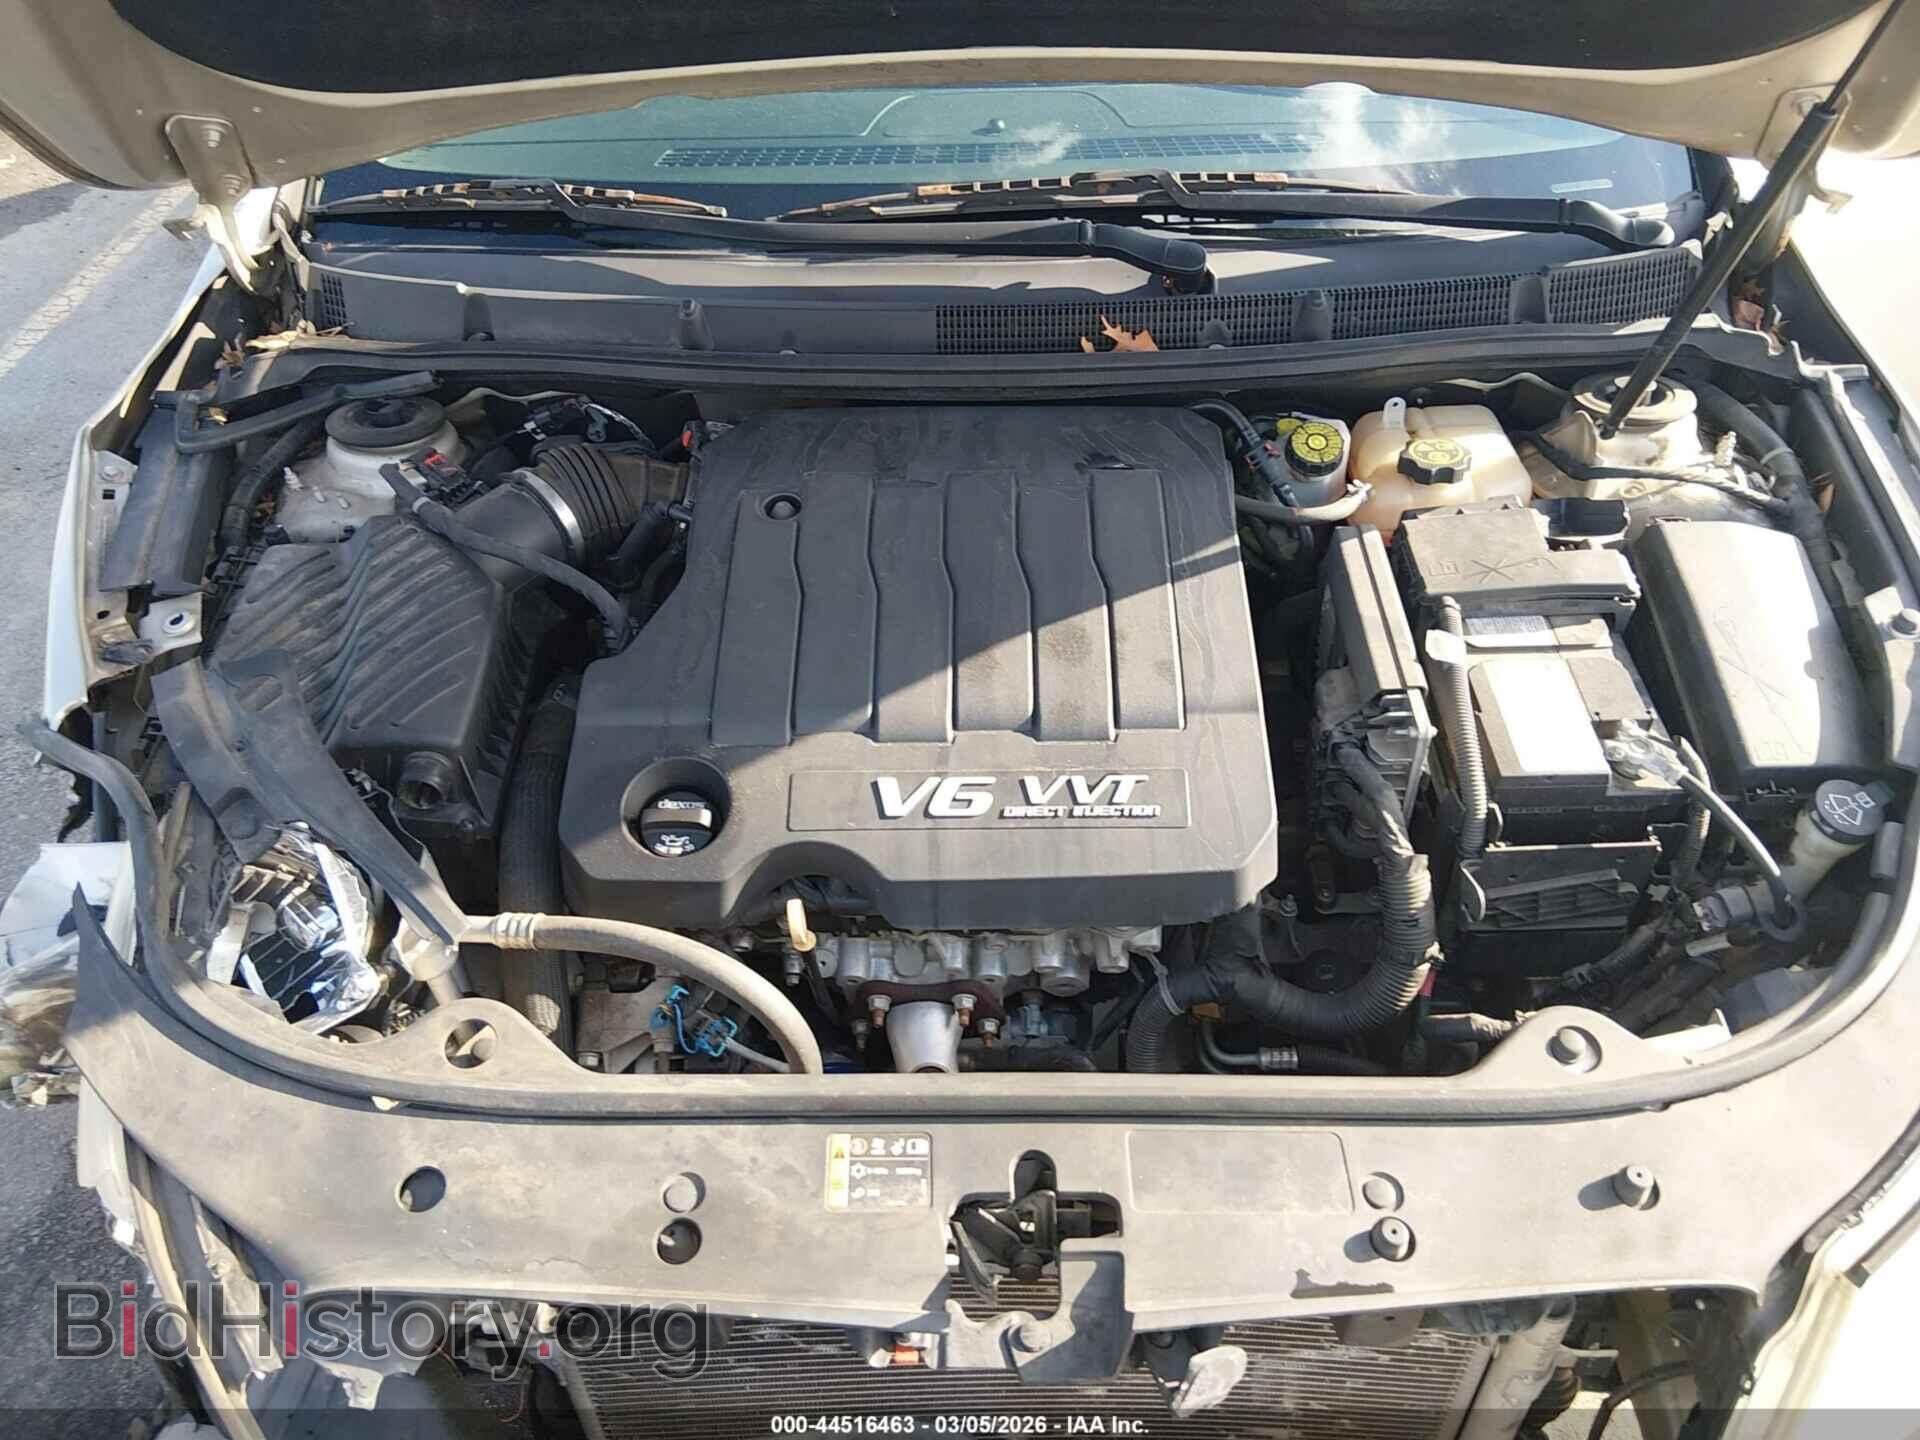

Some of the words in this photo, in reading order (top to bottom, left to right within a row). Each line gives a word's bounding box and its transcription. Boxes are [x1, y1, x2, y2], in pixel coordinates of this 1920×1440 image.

[874, 776, 997, 818] V6
[1021, 774, 1150, 805] VVT
[1001, 805, 1068, 818] DIRECT
[1071, 804, 1161, 818] INJECTION
